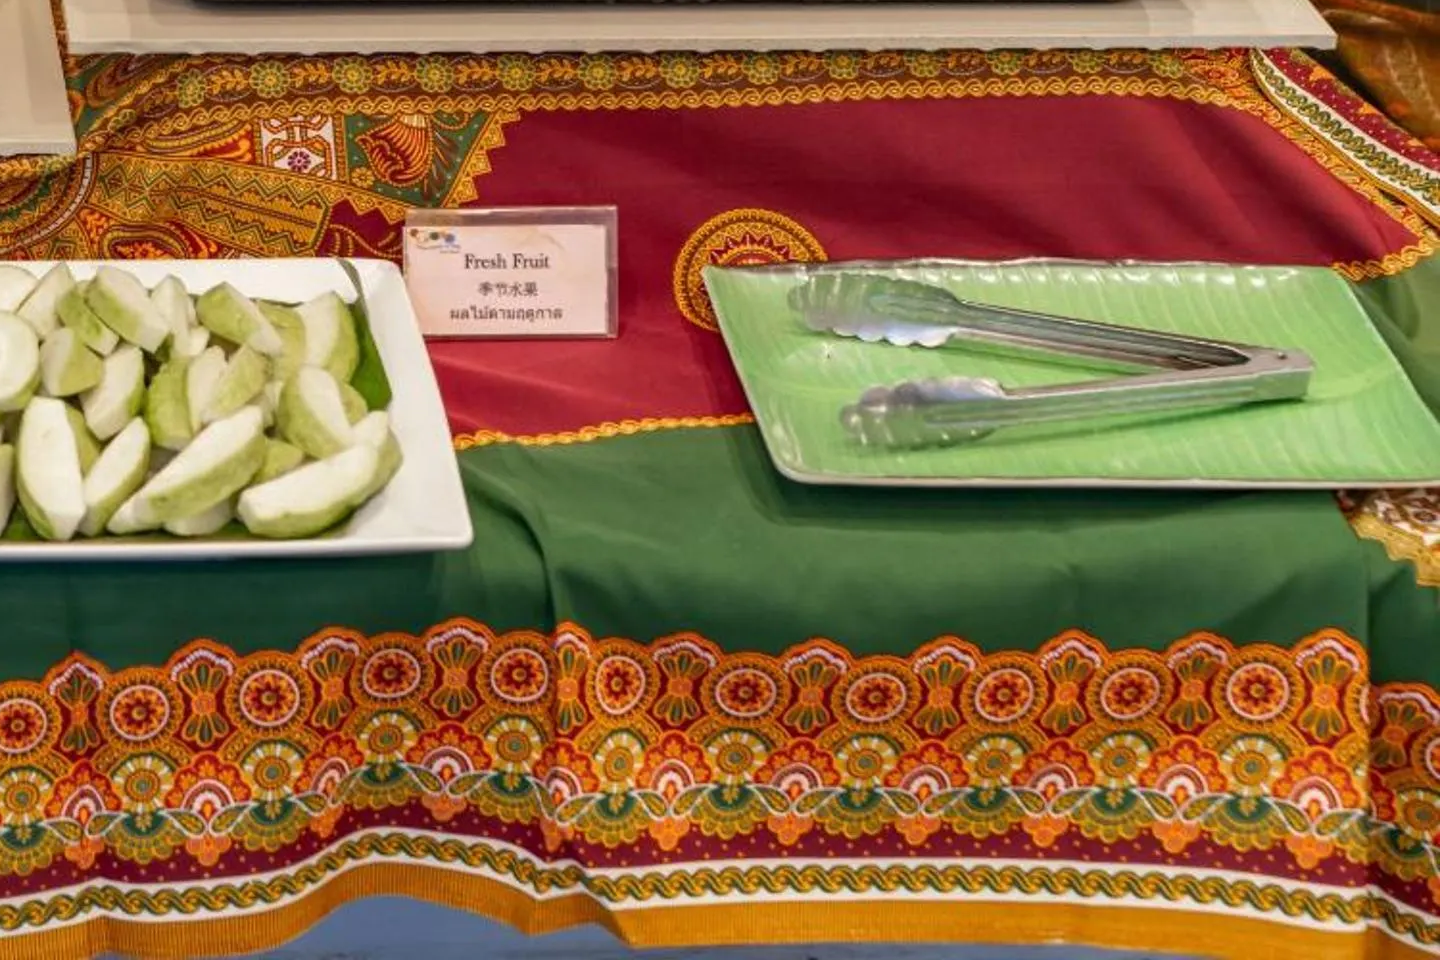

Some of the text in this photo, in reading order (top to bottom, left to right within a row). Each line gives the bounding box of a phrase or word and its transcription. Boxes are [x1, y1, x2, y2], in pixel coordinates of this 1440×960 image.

[464, 253, 551, 269] Fresh Fruit
[478, 281, 539, 297] 季节水果
[449, 304, 563, 323] ผลไม้ตามฤดูกาล
